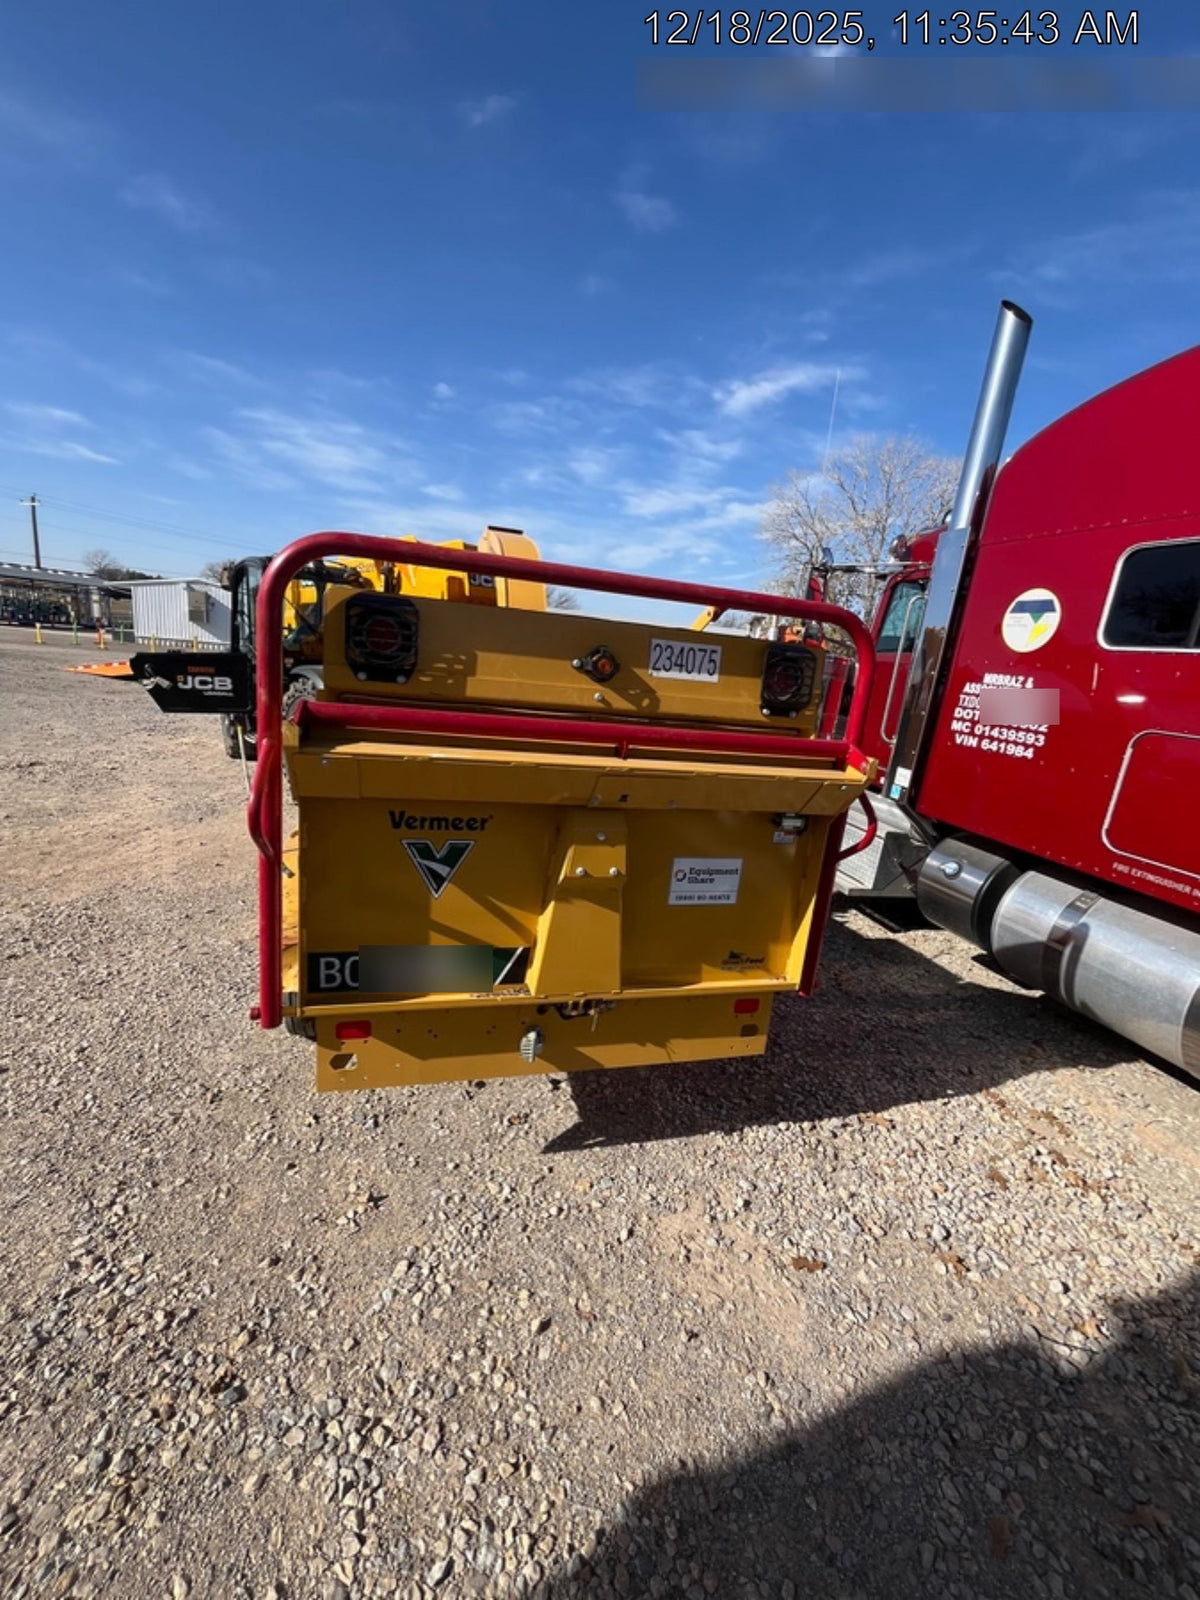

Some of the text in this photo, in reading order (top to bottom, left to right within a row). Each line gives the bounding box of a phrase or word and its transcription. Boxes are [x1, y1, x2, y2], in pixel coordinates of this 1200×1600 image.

[652, 643, 717, 676] 234075
[177, 675, 233, 691] JCB
[954, 707, 980, 720] DOT
[951, 720, 971, 732] MC
[974, 724, 1045, 747] 01439593
[955, 733, 978, 748] VIN
[388, 810, 489, 831] Vermeer
[689, 867, 739, 876] Equipment
[1112, 862, 1130, 874] FIRE
